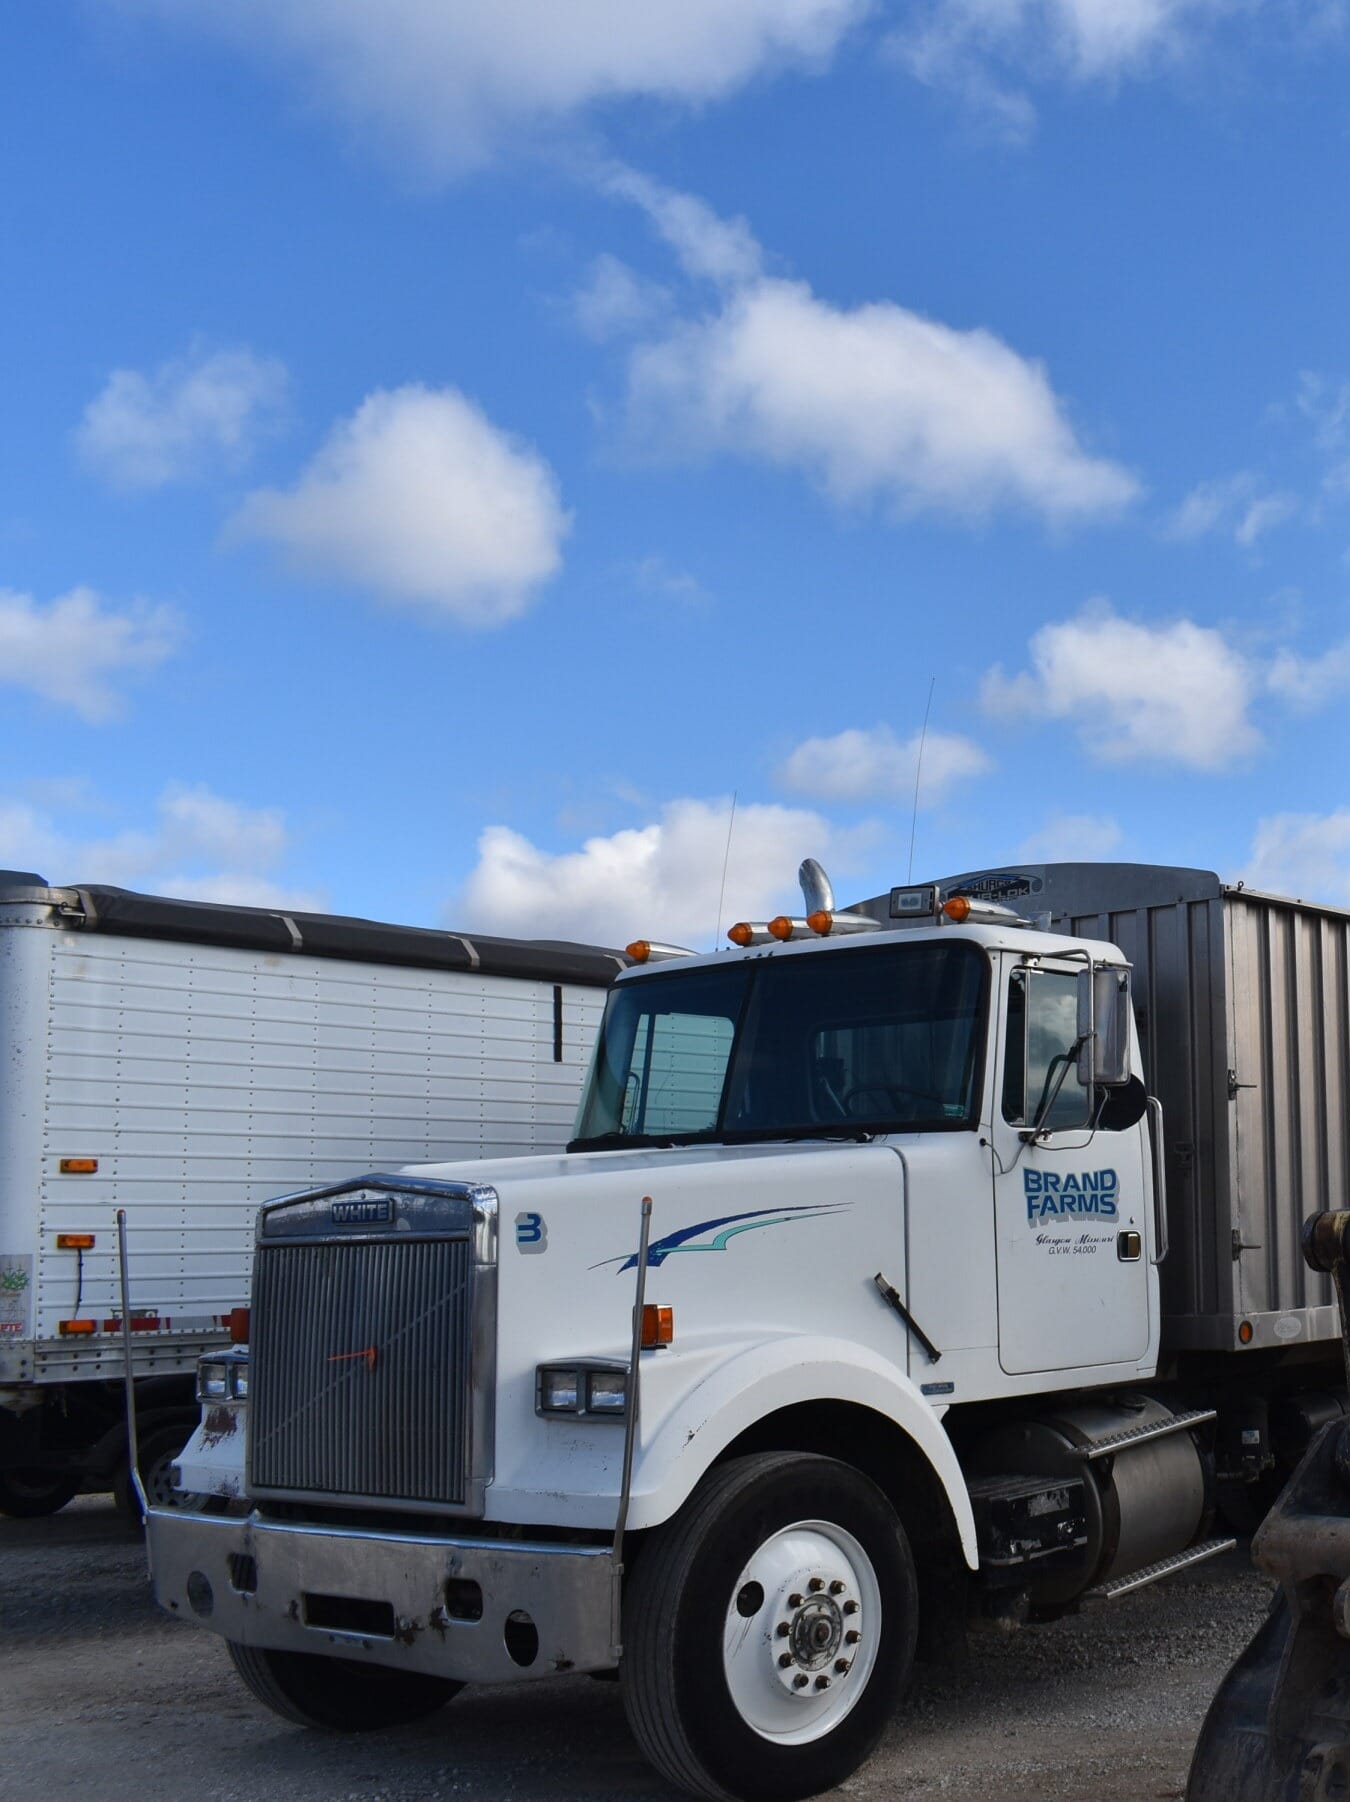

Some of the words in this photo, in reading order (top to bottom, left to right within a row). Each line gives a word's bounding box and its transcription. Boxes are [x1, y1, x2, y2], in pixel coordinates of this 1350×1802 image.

[1023, 1168, 1117, 1192] BRAND
[333, 1203, 388, 1221] WHITE
[1026, 1193, 1116, 1220] FARMS
